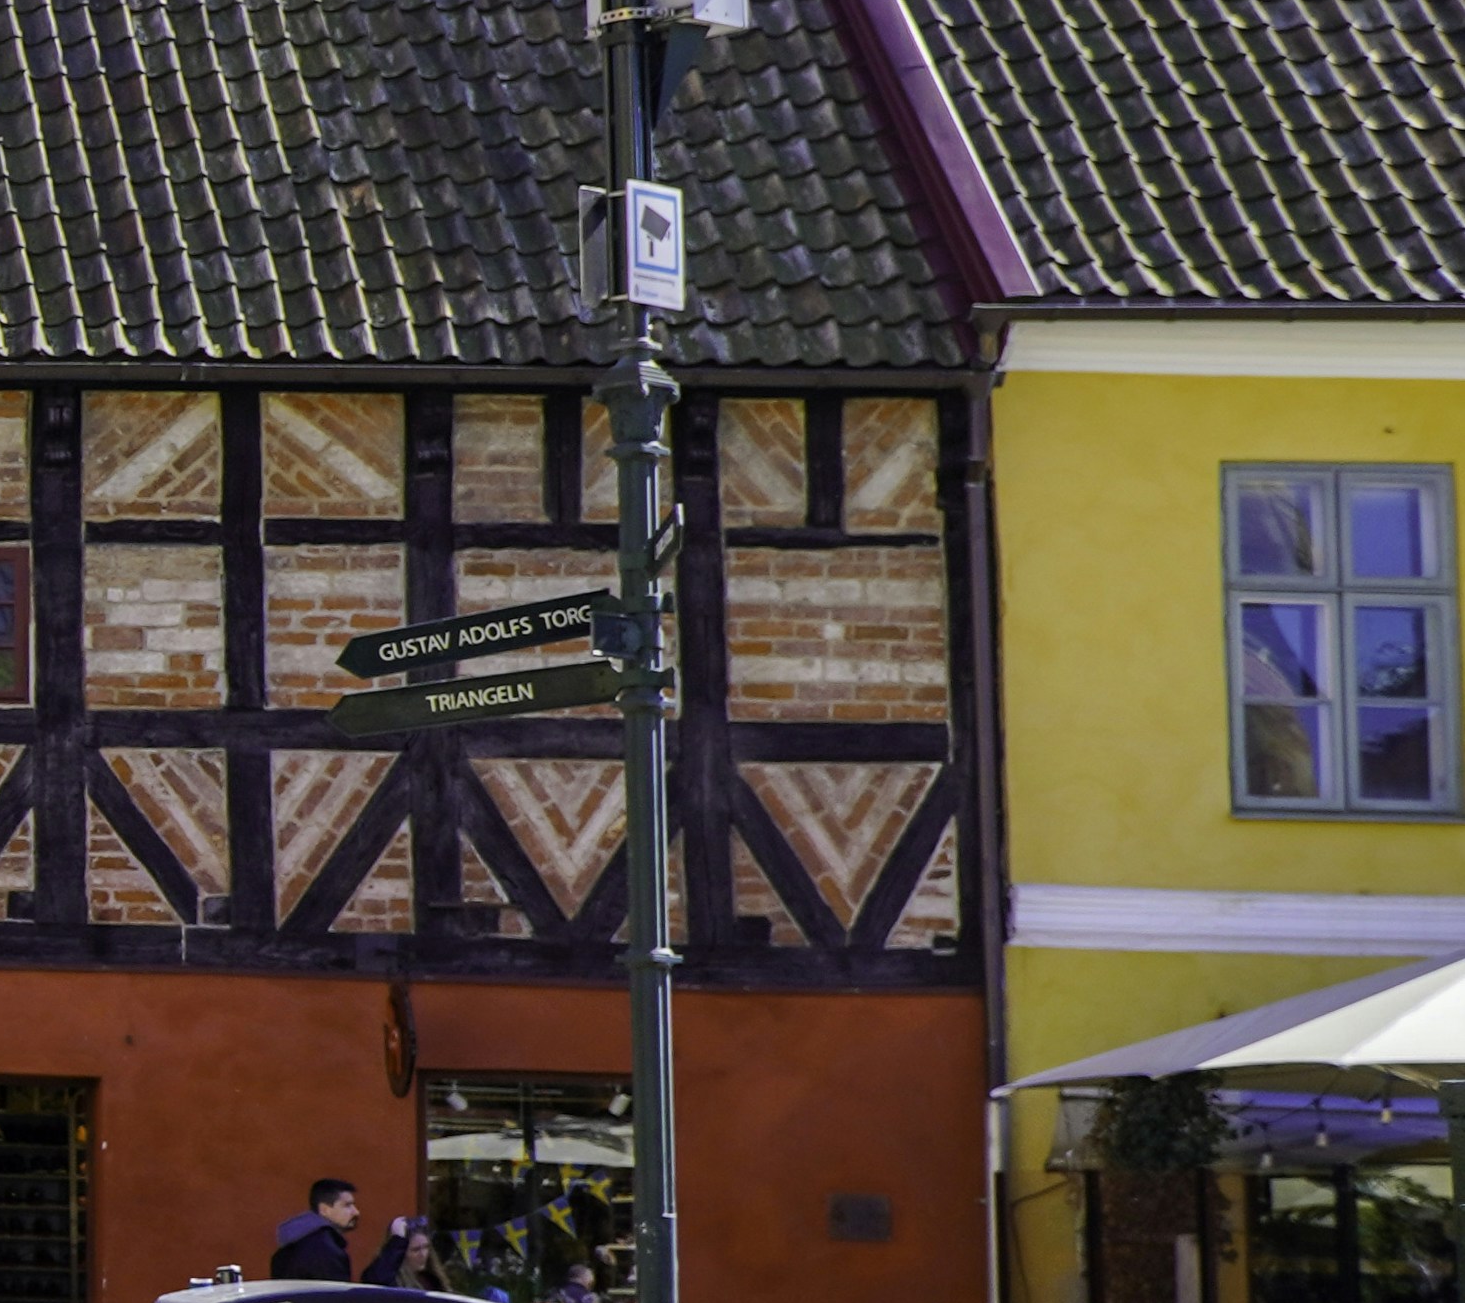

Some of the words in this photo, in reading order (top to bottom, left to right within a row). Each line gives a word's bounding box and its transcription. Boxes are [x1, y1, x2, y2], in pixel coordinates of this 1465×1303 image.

[378, 630, 451, 662] GUSTAV
[458, 615, 533, 647] ADOLFS
[538, 604, 592, 631] TORG
[425, 682, 535, 713] TRIANGELN
